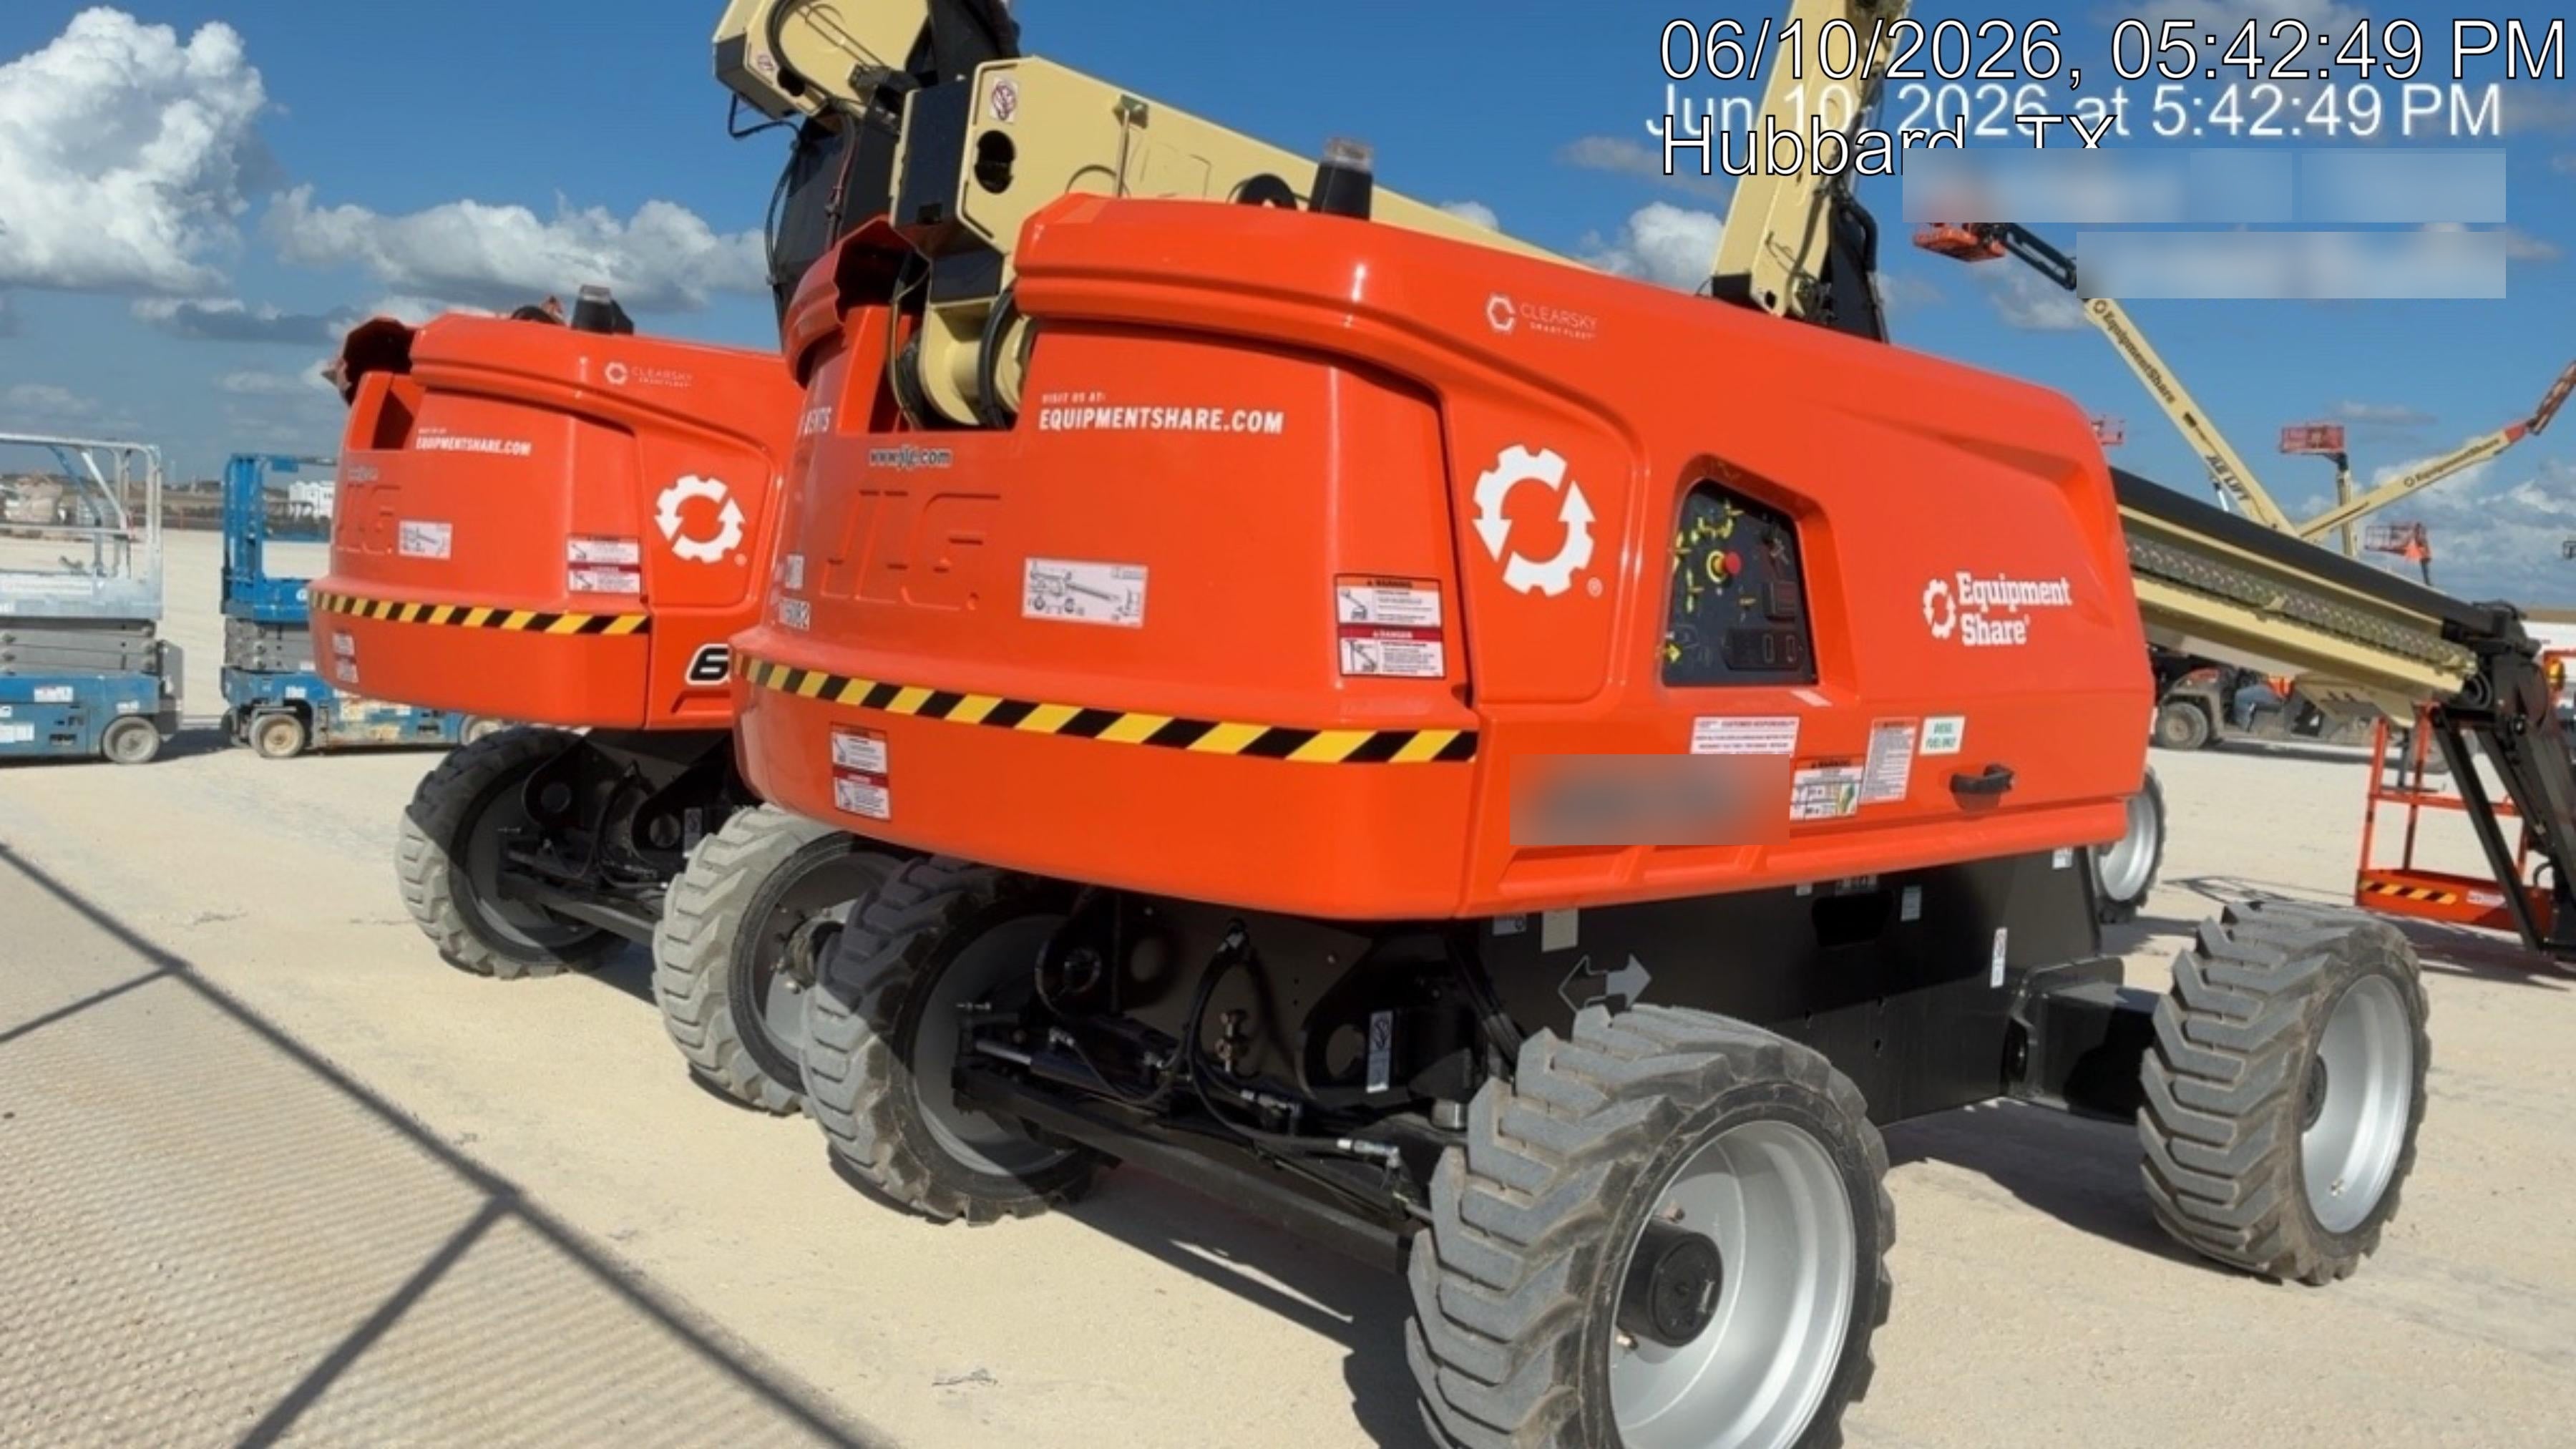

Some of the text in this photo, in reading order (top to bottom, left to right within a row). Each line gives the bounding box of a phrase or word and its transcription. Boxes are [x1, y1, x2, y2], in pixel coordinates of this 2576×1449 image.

[1039, 406, 1284, 434] EQUIPMENTSHARE.COM
[416, 435, 532, 457] EQUIPMENTSHARE.COM
[1955, 572, 2073, 613] Equipment
